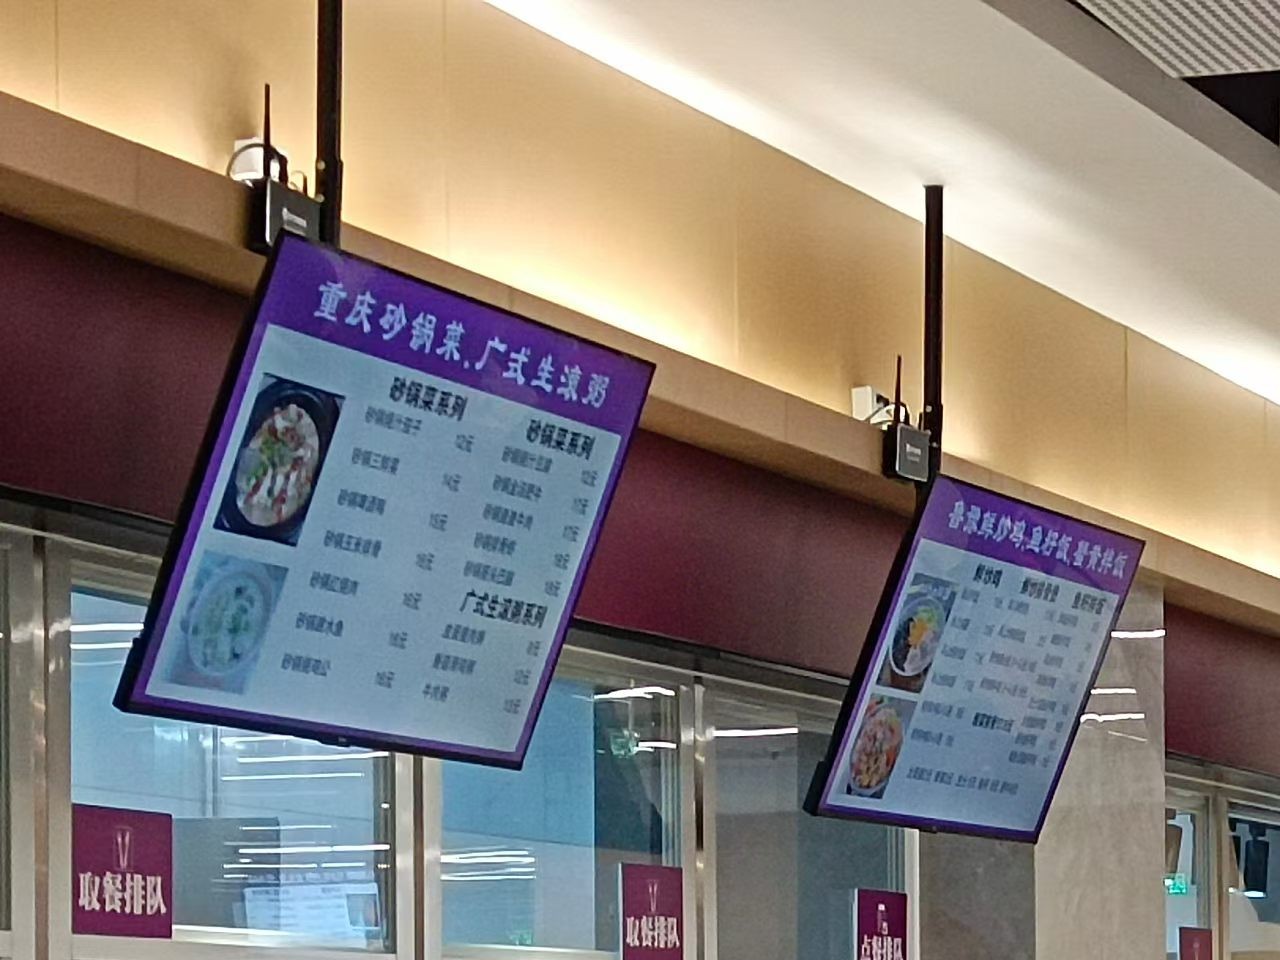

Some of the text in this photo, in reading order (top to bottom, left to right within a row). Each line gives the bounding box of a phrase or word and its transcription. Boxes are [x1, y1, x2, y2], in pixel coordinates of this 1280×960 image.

[78, 871, 167, 915] 取餐排队
[626, 915, 680, 948] 取餐排队
